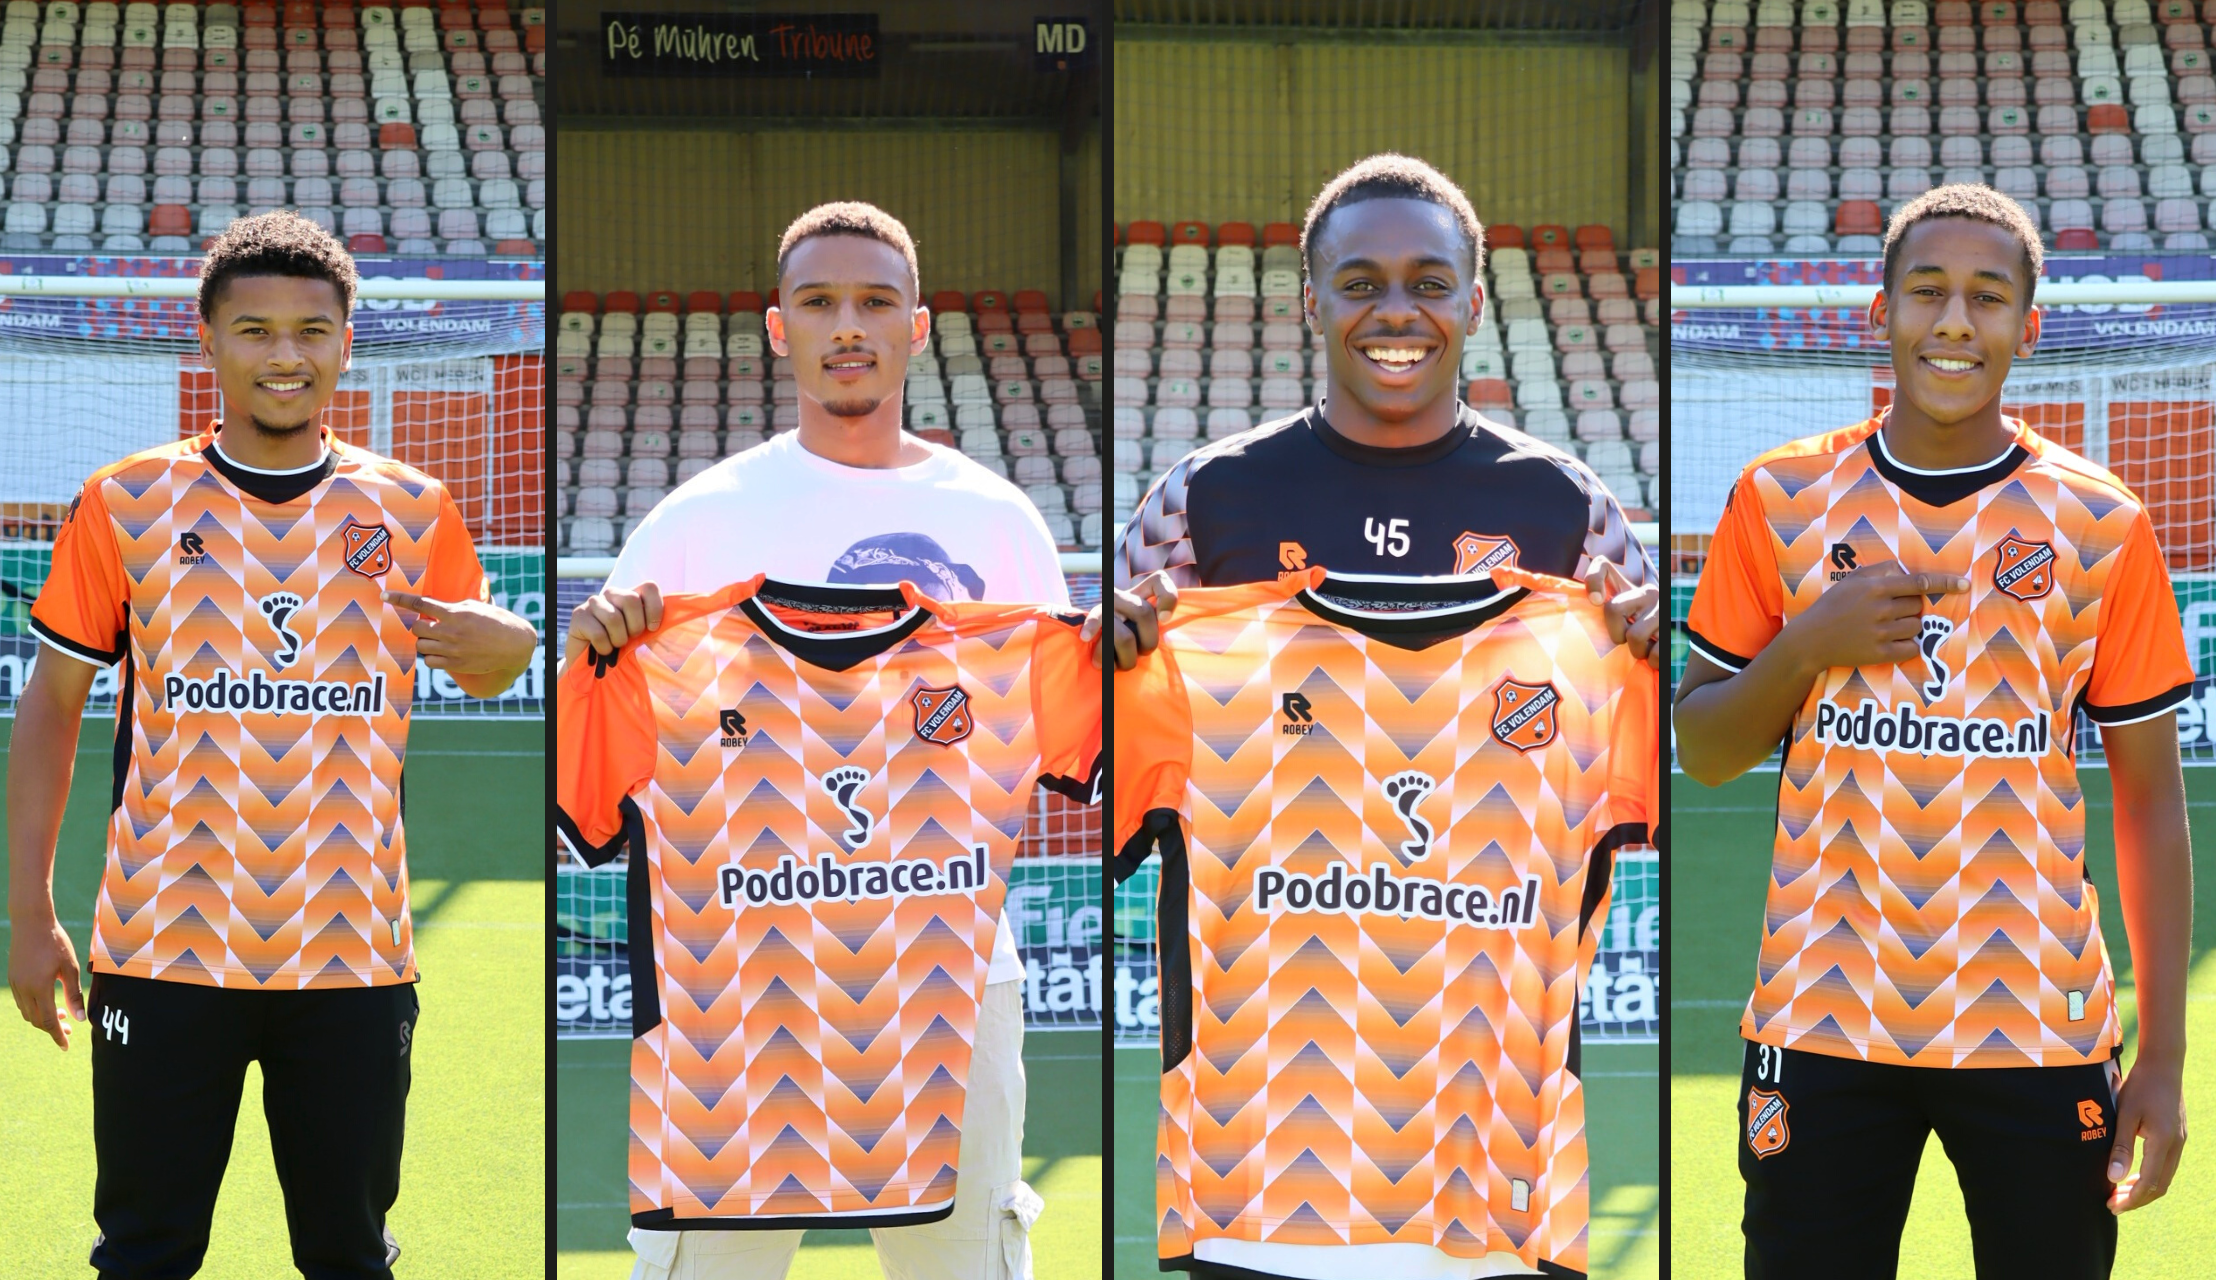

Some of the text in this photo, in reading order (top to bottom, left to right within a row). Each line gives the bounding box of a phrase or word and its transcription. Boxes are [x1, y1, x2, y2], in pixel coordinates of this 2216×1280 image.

[608, 21, 643, 59] Pé
[769, 23, 875, 61] Tribune
[1037, 23, 1086, 53] MD
[381, 318, 491, 332] VOLENDAM
[348, 529, 388, 569] FC VOLENDAM
[1363, 517, 1411, 558] 45
[179, 556, 205, 565] ROBEY
[1997, 547, 2053, 588] FC VOLENDAM
[165, 671, 384, 713] Podobrace.nl
[920, 690, 965, 739] FC VOLENDAM
[1282, 723, 1314, 736] ROBEY
[1495, 689, 1555, 738] FC VOLENDAM
[1815, 701, 2048, 754] Podobrace.nl
[720, 736, 748, 748] ROBEY
[720, 847, 987, 905] Podobrace.nl
[1257, 866, 1539, 926] Podobrace.nl
[102, 1005, 129, 1045] 44
[1757, 1043, 1782, 1083] 31
[2081, 1126, 2107, 1142] ROBEY
